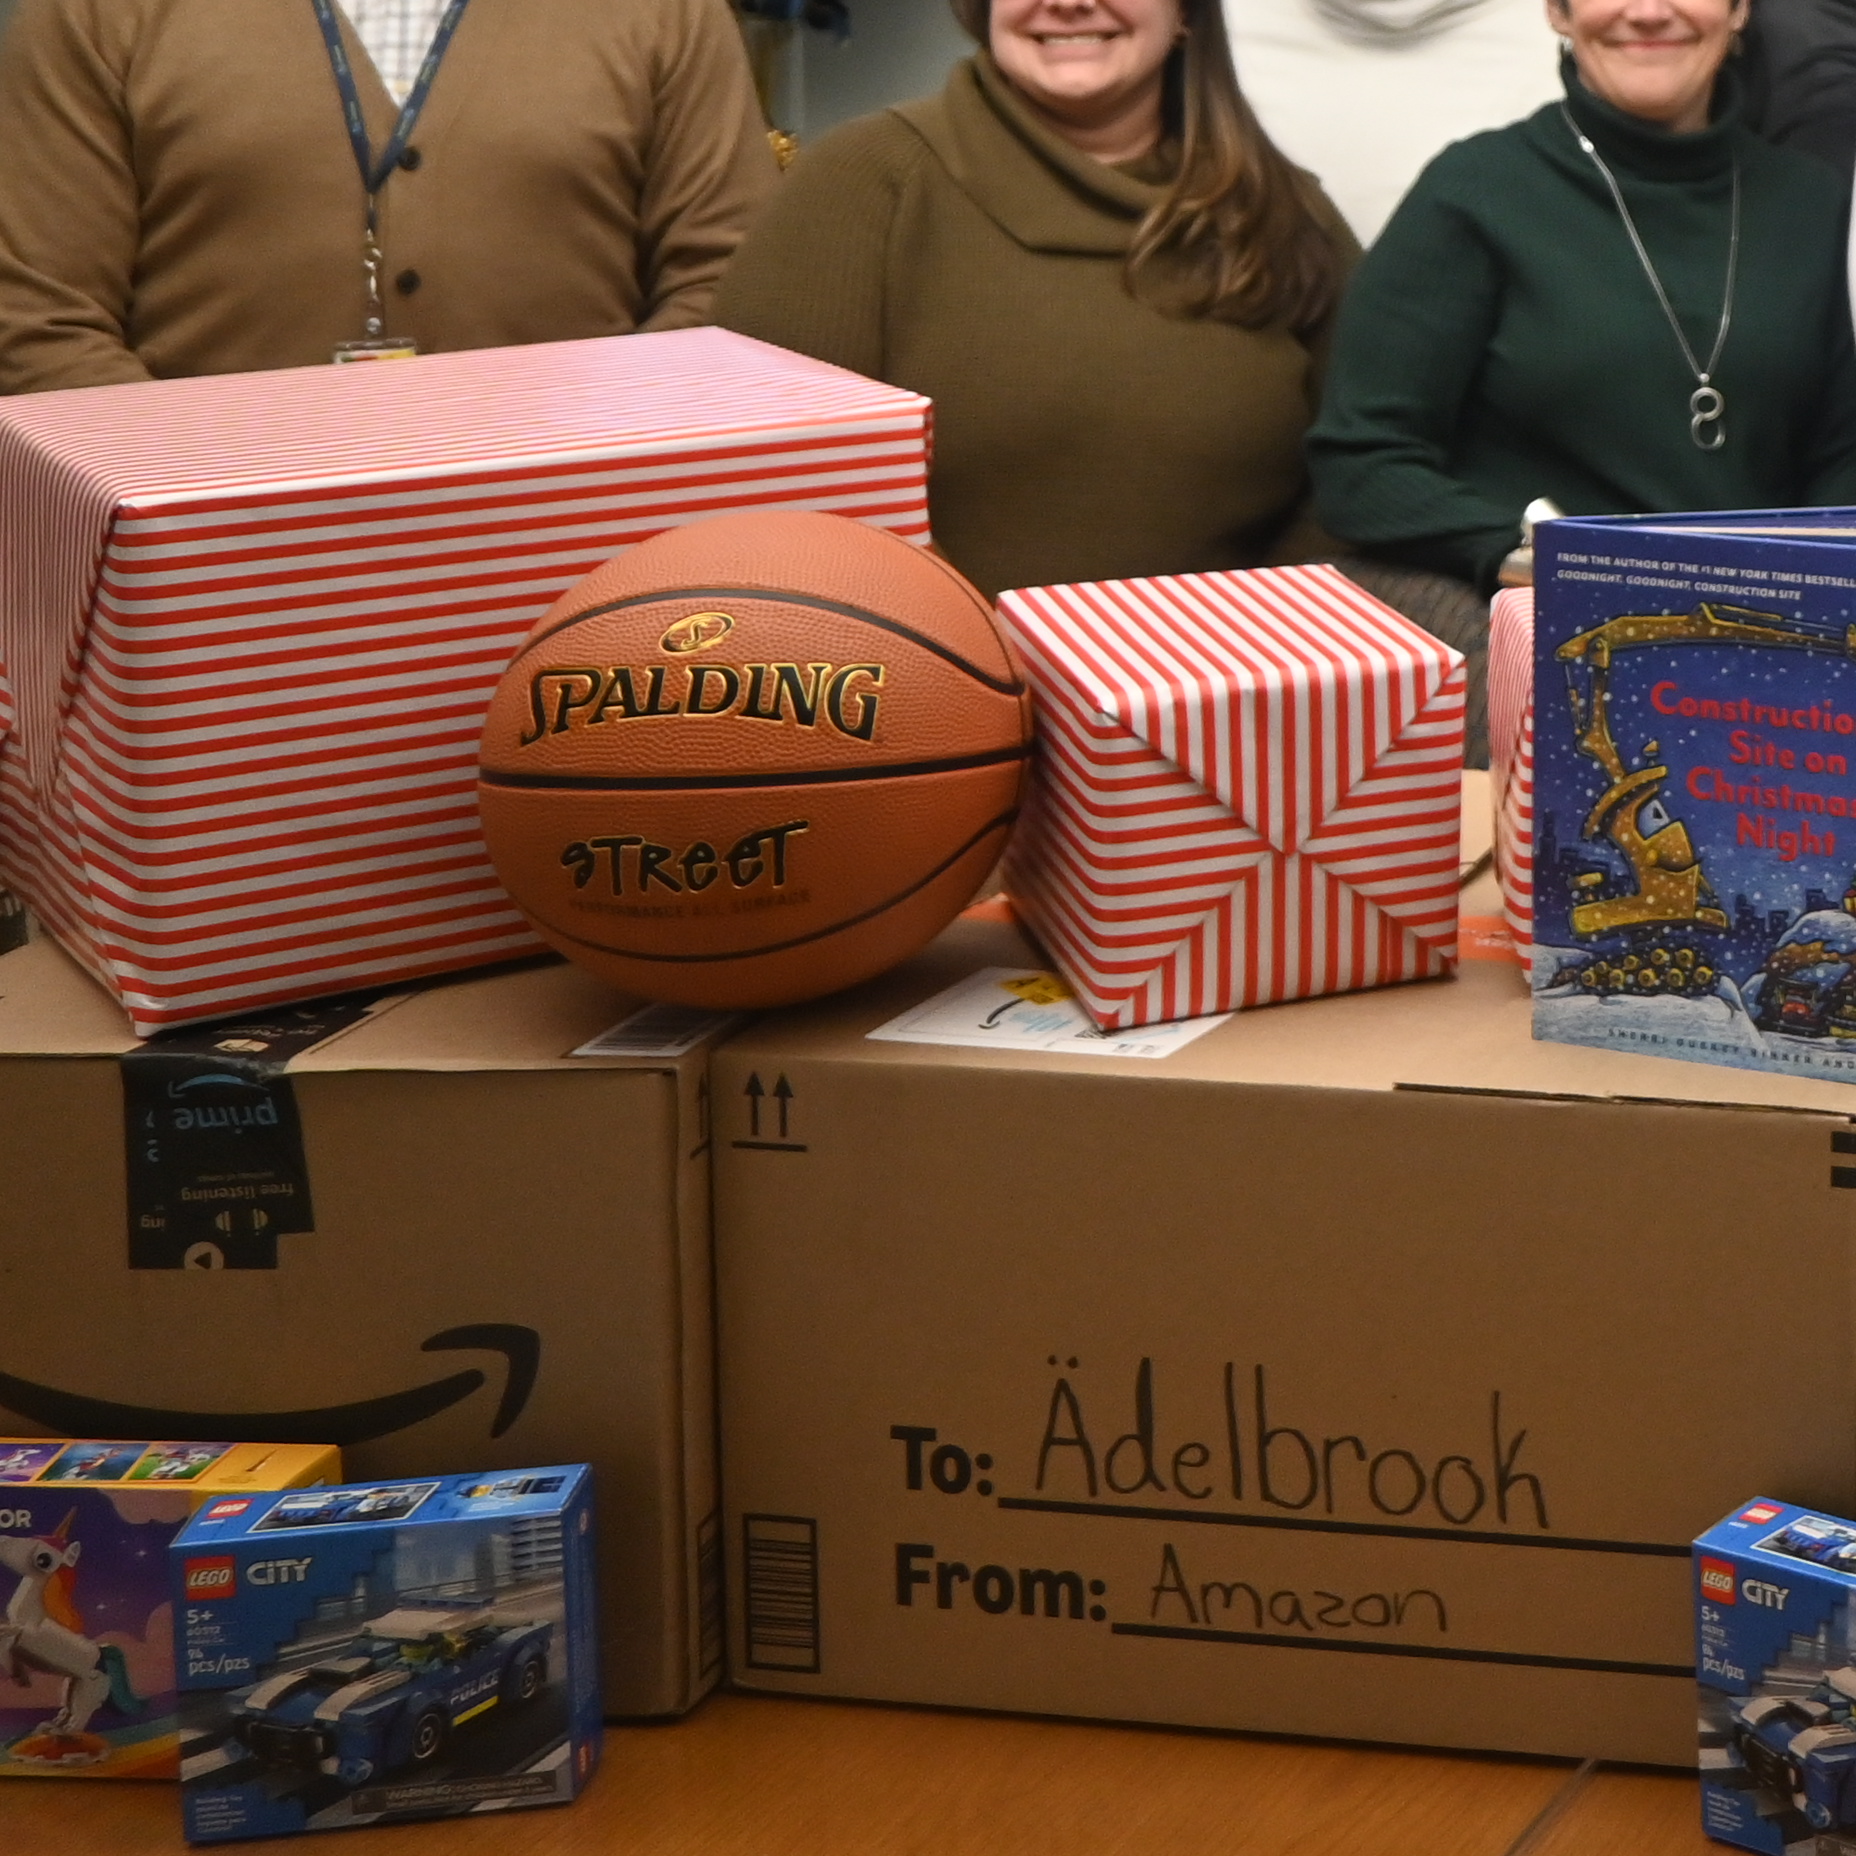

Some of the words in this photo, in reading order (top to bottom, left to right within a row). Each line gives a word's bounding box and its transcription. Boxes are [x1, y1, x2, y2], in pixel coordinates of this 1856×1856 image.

[1557, 552, 1588, 564] FROM
[1590, 555, 1611, 566] THE
[1613, 557, 1659, 570] AUTHOR
[1661, 560, 1677, 572] OF
[1678, 562, 1699, 574] THE
[1713, 566, 1737, 577] NEW
[1739, 568, 1769, 581] YORK
[1771, 571, 1802, 583] TIMES
[1694, 580, 1776, 598] CONSTRUCTION
[1778, 589, 1802, 601] SITE
[520, 662, 885, 746] SPALDING
[1729, 730, 1795, 770] Site
[1804, 751, 1848, 775] on
[1737, 811, 1837, 862] Night
[174, 1096, 279, 1134] prime
[181, 1186, 256, 1202] listening
[259, 1183, 295, 1198] free
[890, 1425, 994, 1498] To:
[188, 1567, 232, 1587] LEGO
[895, 1544, 1108, 1623] From:
[1150, 1542, 1448, 1634] Amazon
[1702, 1570, 1734, 1591] LEGO
[187, 1609, 213, 1624] 5+
[1701, 1606, 1720, 1622] 5+
